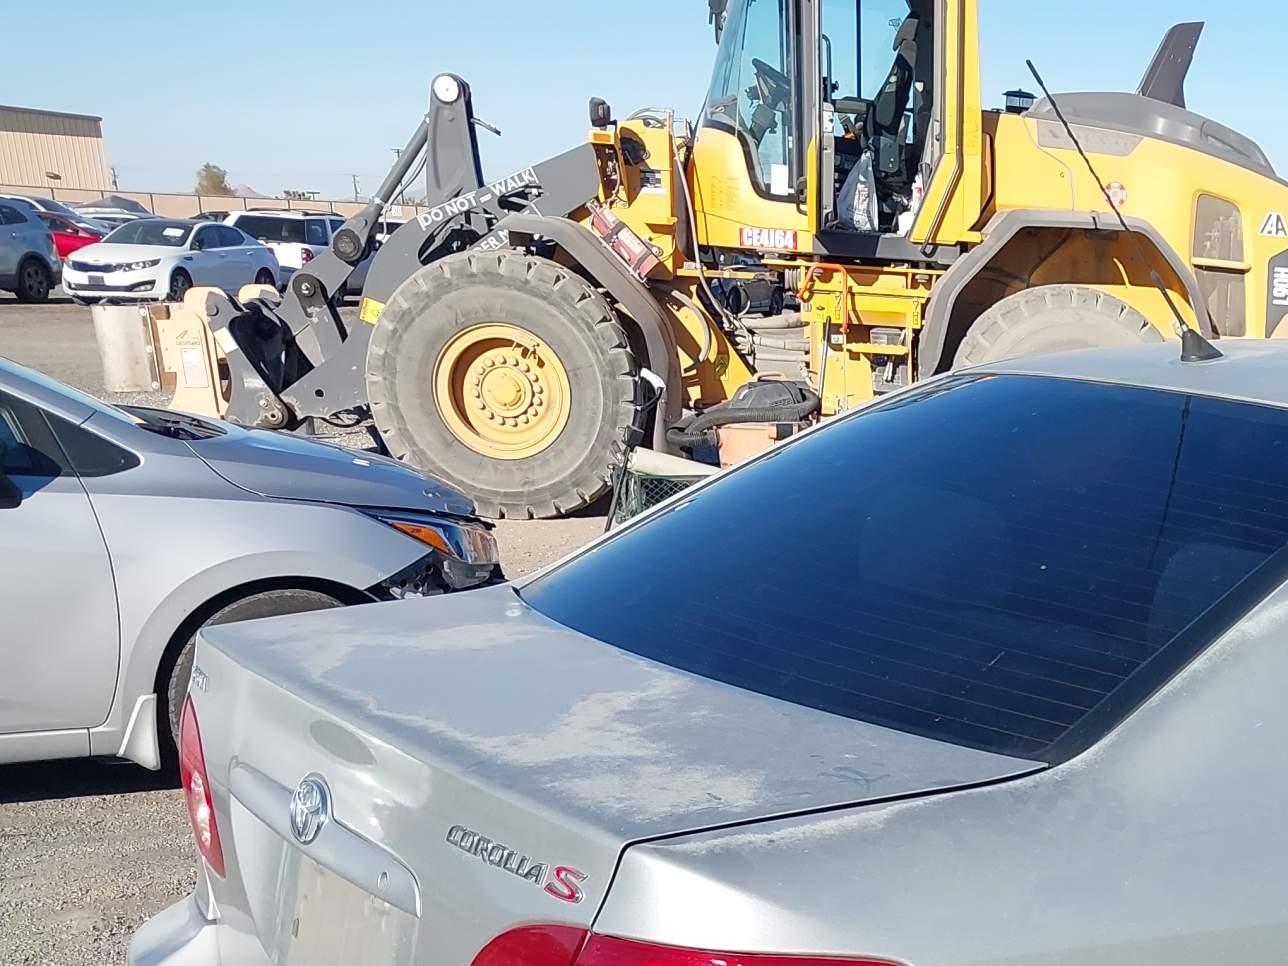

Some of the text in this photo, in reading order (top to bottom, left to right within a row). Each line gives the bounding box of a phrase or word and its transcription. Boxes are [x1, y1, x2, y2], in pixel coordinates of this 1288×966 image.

[420, 168, 535, 228] DO NOT WALK
[445, 823, 590, 904] COROLLA S
